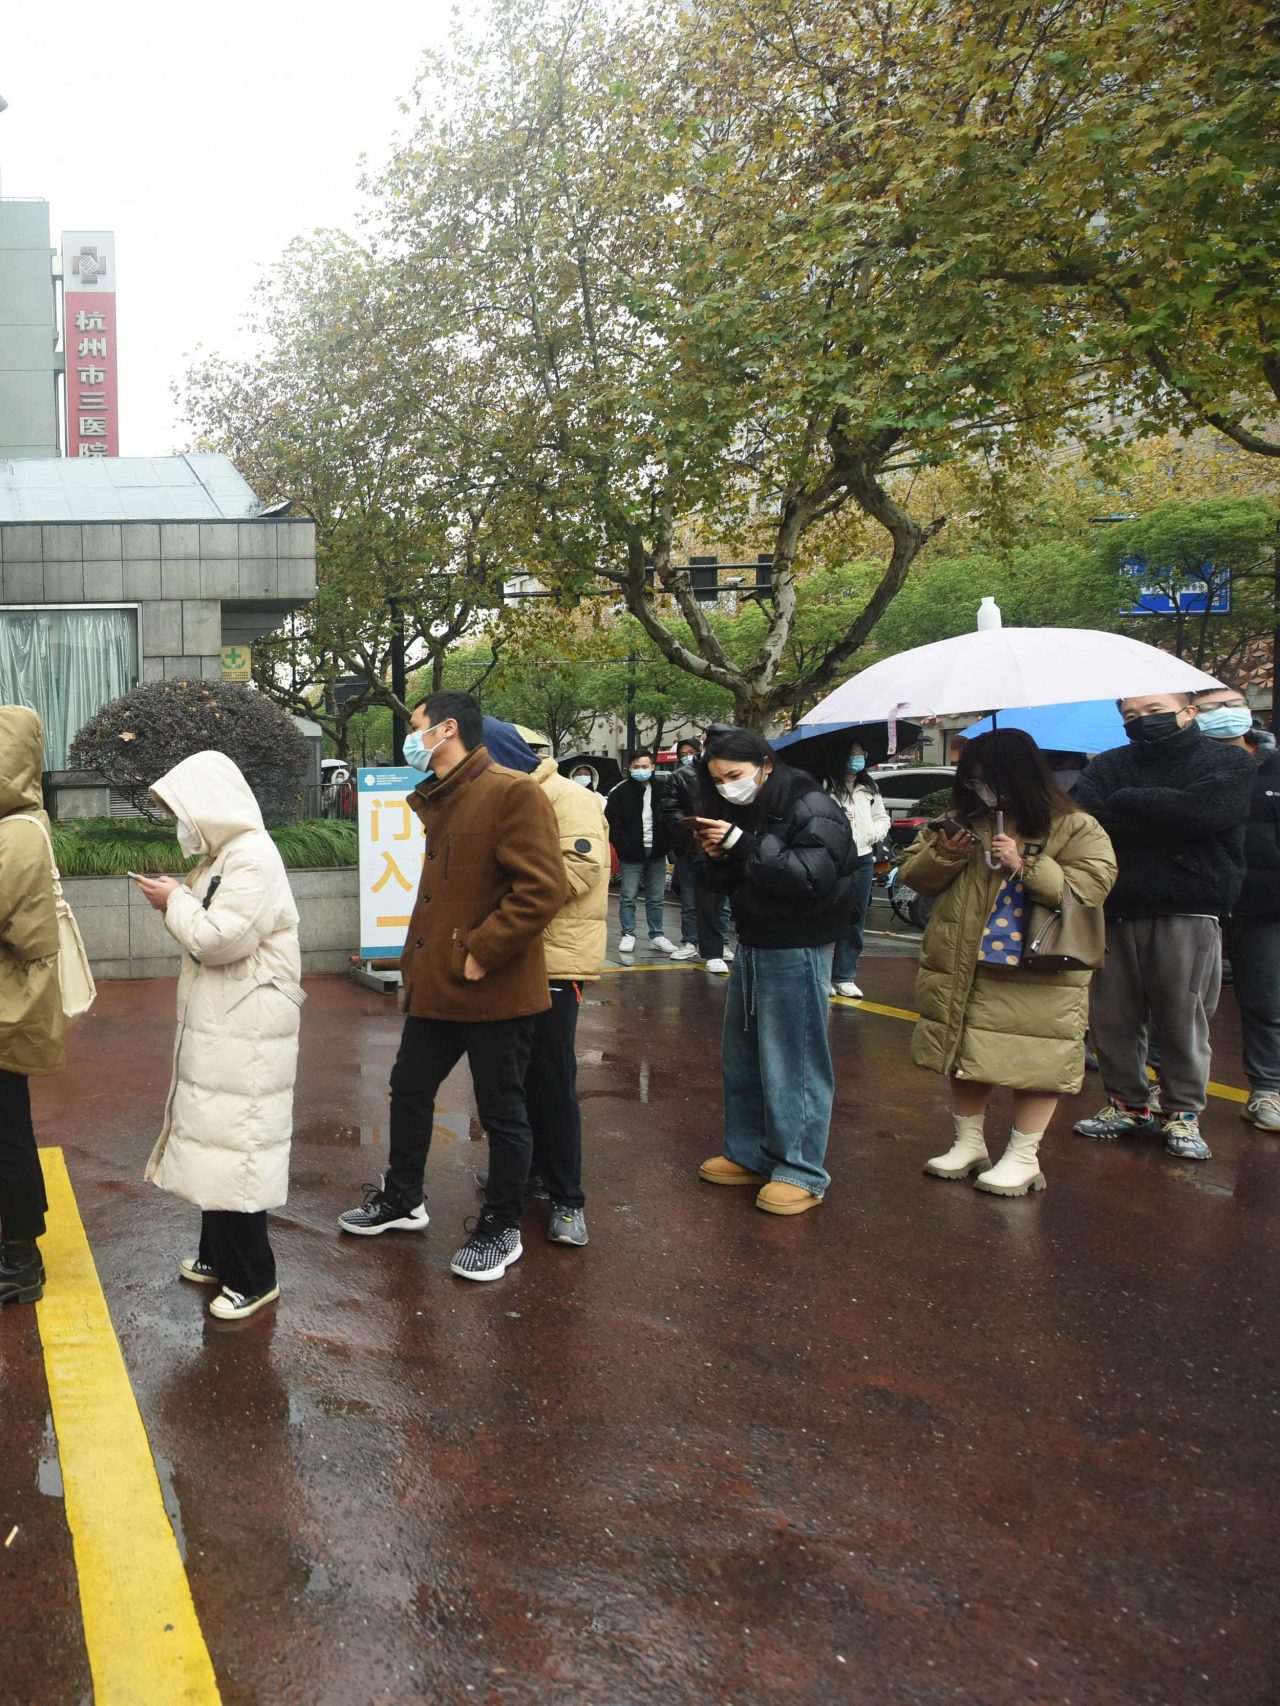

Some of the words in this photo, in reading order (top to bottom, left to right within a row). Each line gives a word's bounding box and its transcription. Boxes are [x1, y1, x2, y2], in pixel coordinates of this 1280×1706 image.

[75, 310, 108, 458] 杭州市三医院
